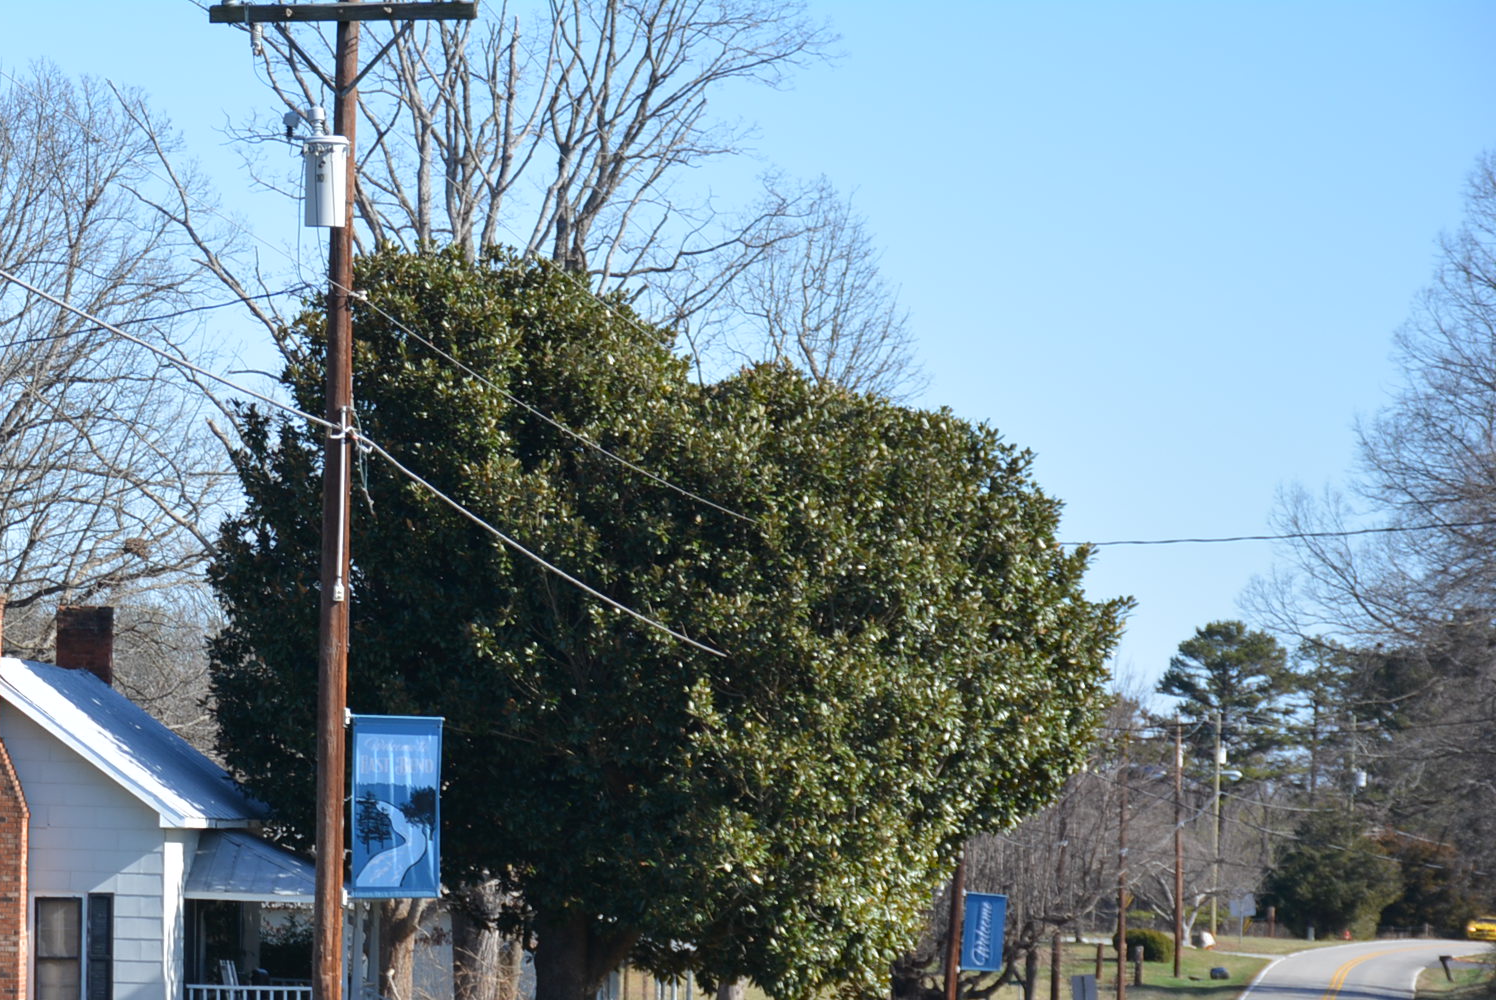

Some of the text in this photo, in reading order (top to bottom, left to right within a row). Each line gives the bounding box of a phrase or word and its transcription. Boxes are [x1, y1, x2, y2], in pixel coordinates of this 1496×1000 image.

[364, 736, 413, 752] Welcome
[360, 755, 434, 775] EAST BEND
[971, 901, 992, 966] Welcome
